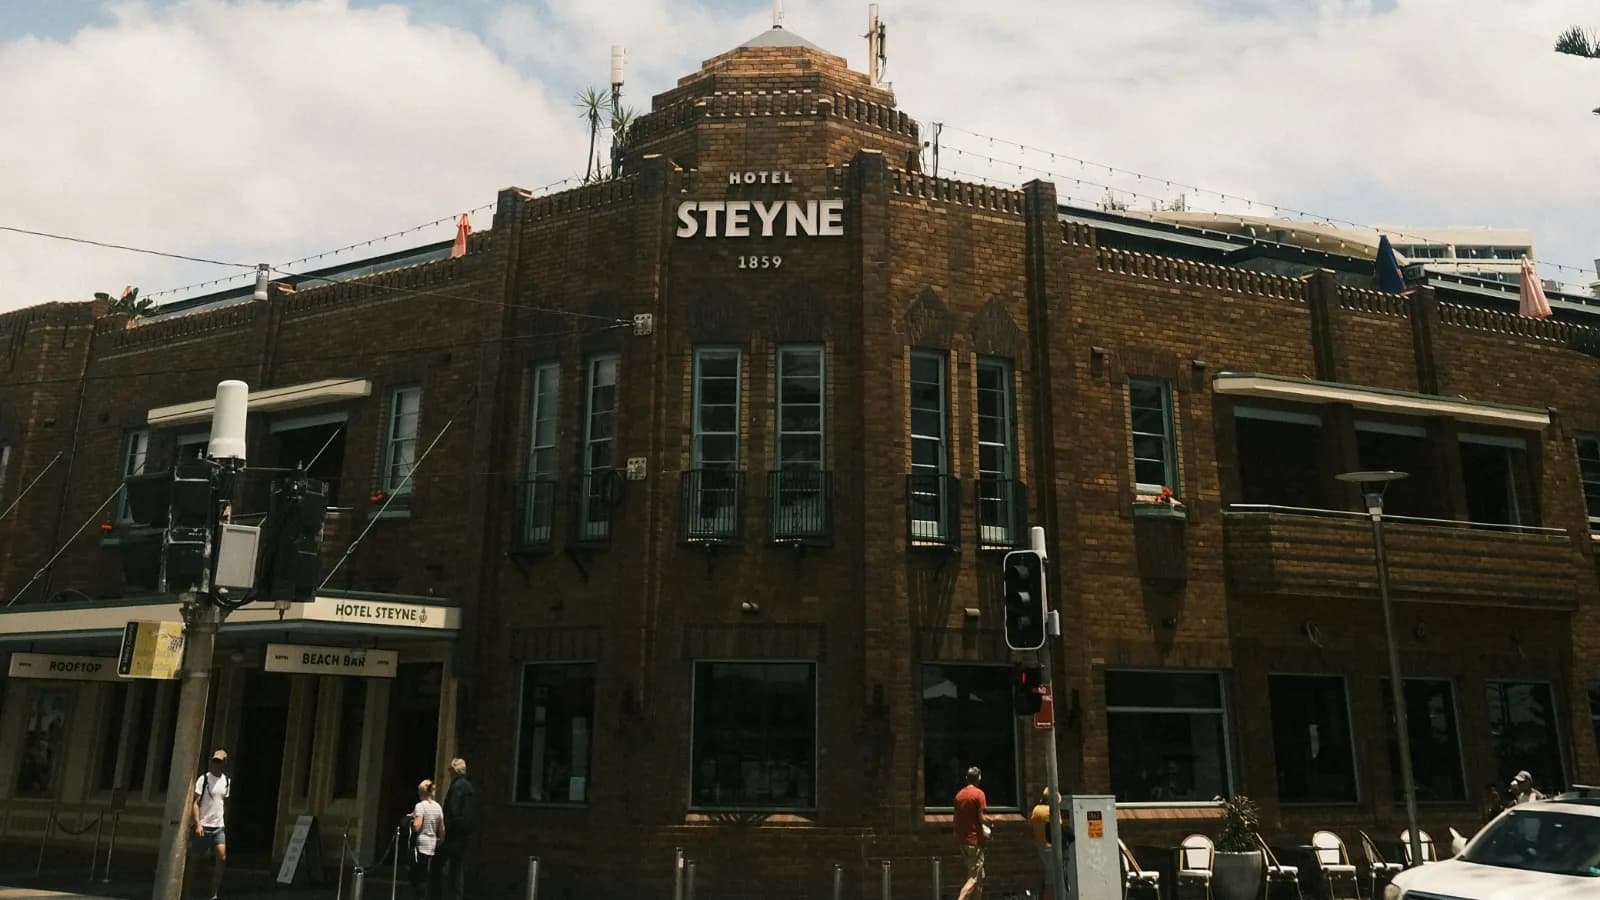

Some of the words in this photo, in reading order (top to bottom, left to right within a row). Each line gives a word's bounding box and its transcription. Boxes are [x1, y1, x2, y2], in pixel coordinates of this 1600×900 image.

[729, 171, 793, 185] HOTEL
[676, 200, 844, 238] STEYNE
[737, 256, 782, 269] 1859
[335, 603, 372, 618] HOTEL
[375, 606, 417, 621] STEYNE
[302, 652, 340, 666] BEACH
[343, 655, 366, 667] BAR
[49, 661, 103, 673] ROOFTOP
